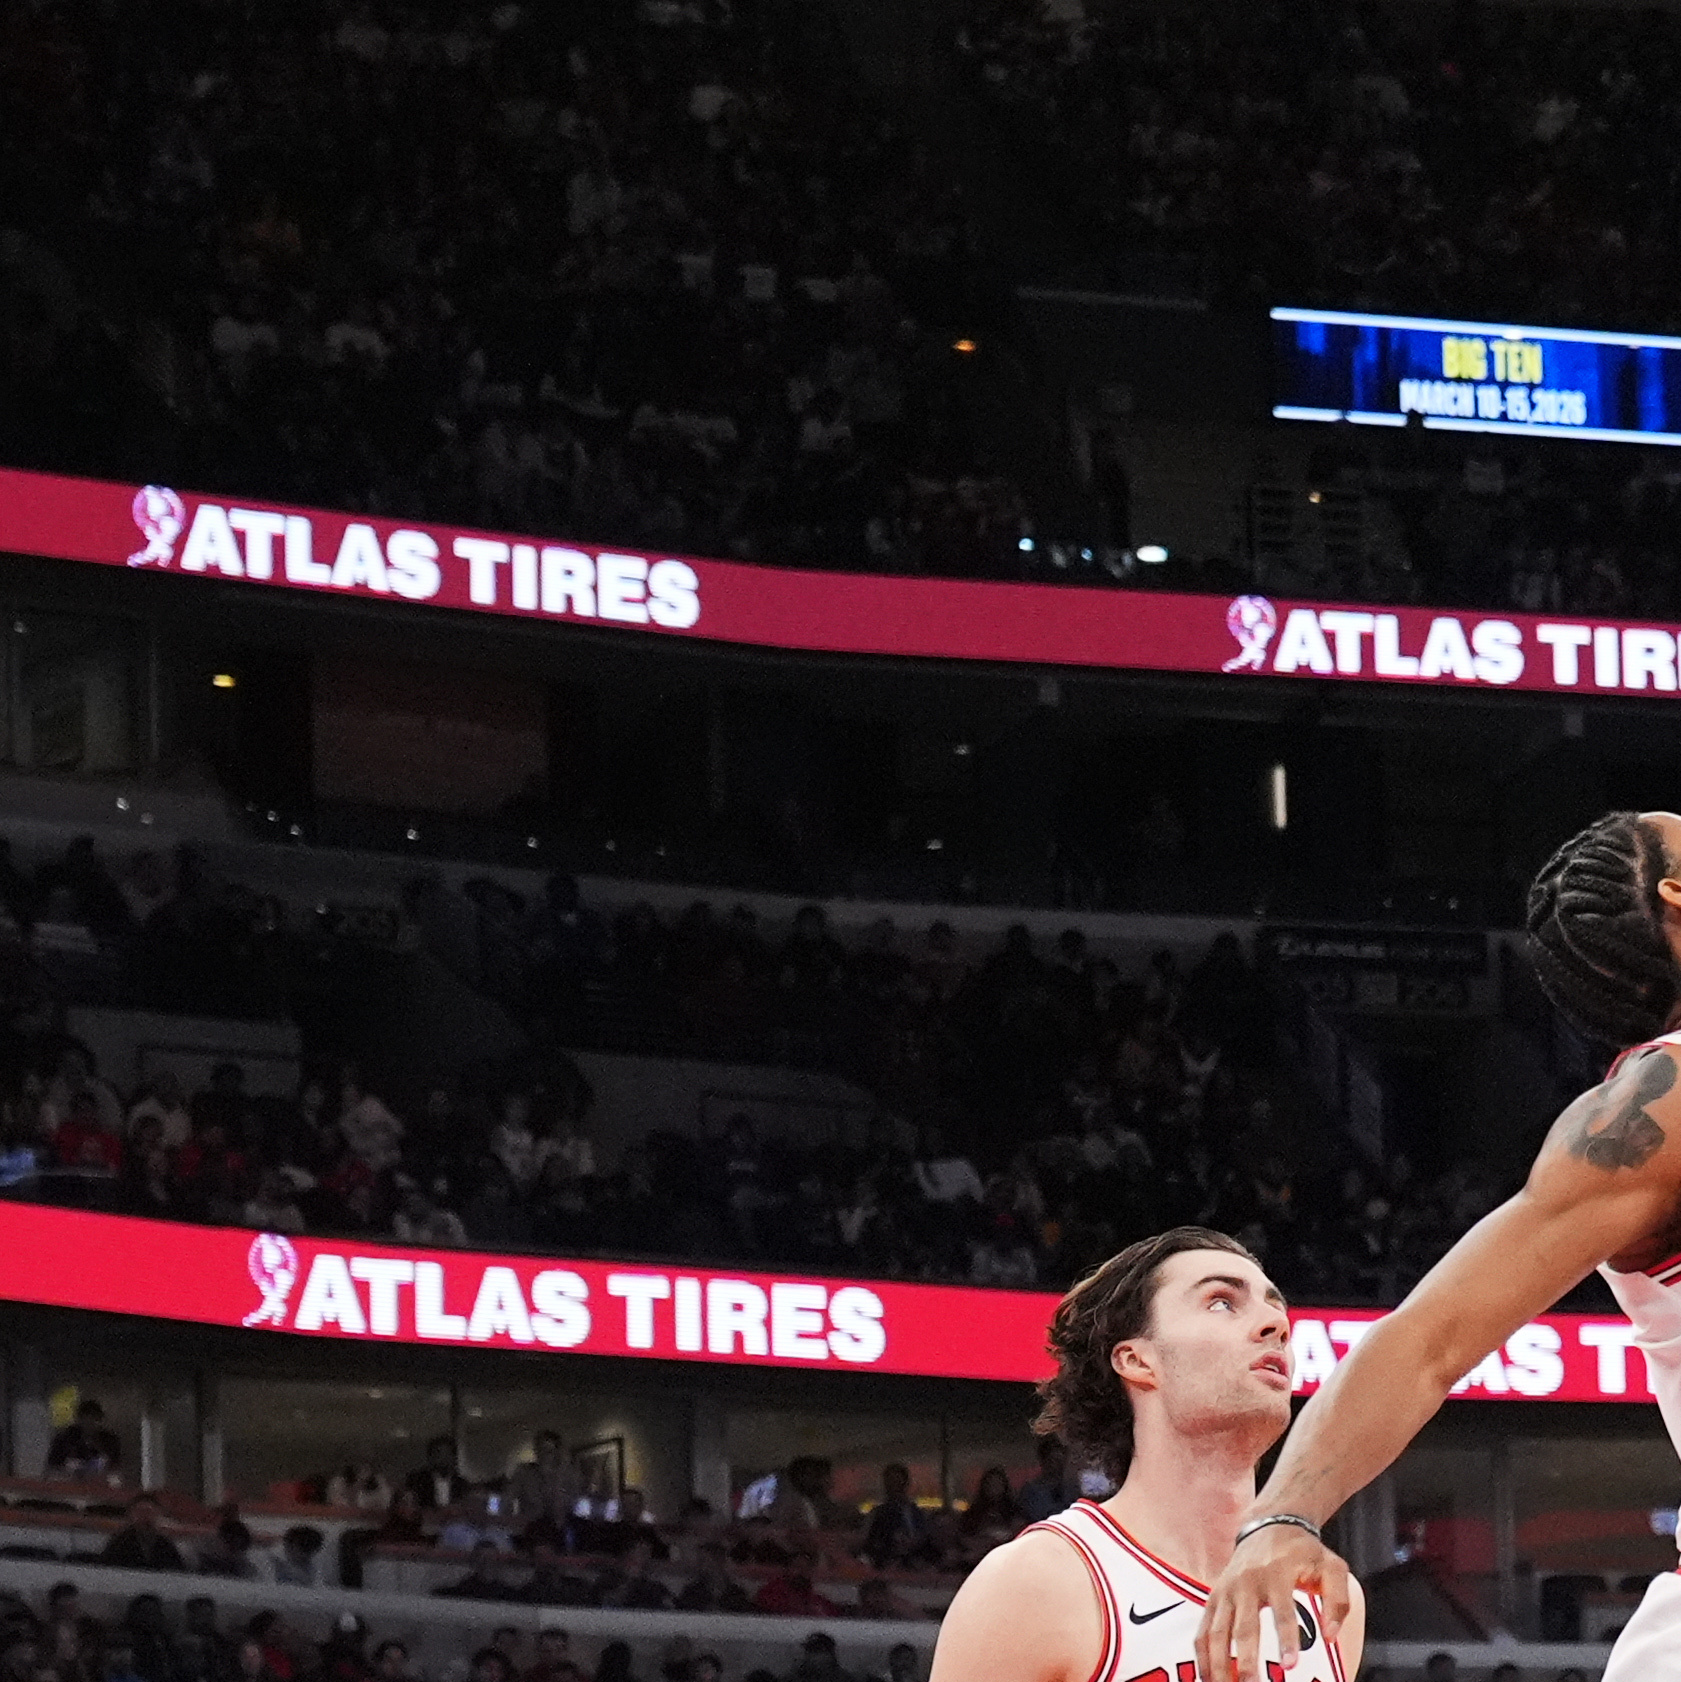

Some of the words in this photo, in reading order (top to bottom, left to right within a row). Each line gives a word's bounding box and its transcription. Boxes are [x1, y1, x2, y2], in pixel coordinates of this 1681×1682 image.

[1492, 340, 1543, 384] TEN
[180, 503, 441, 600] ATLAS
[453, 536, 701, 629] TIRES
[1274, 609, 1524, 686] ATLAS
[296, 1253, 592, 1348] ATLAS
[607, 1273, 887, 1364] TIRES
